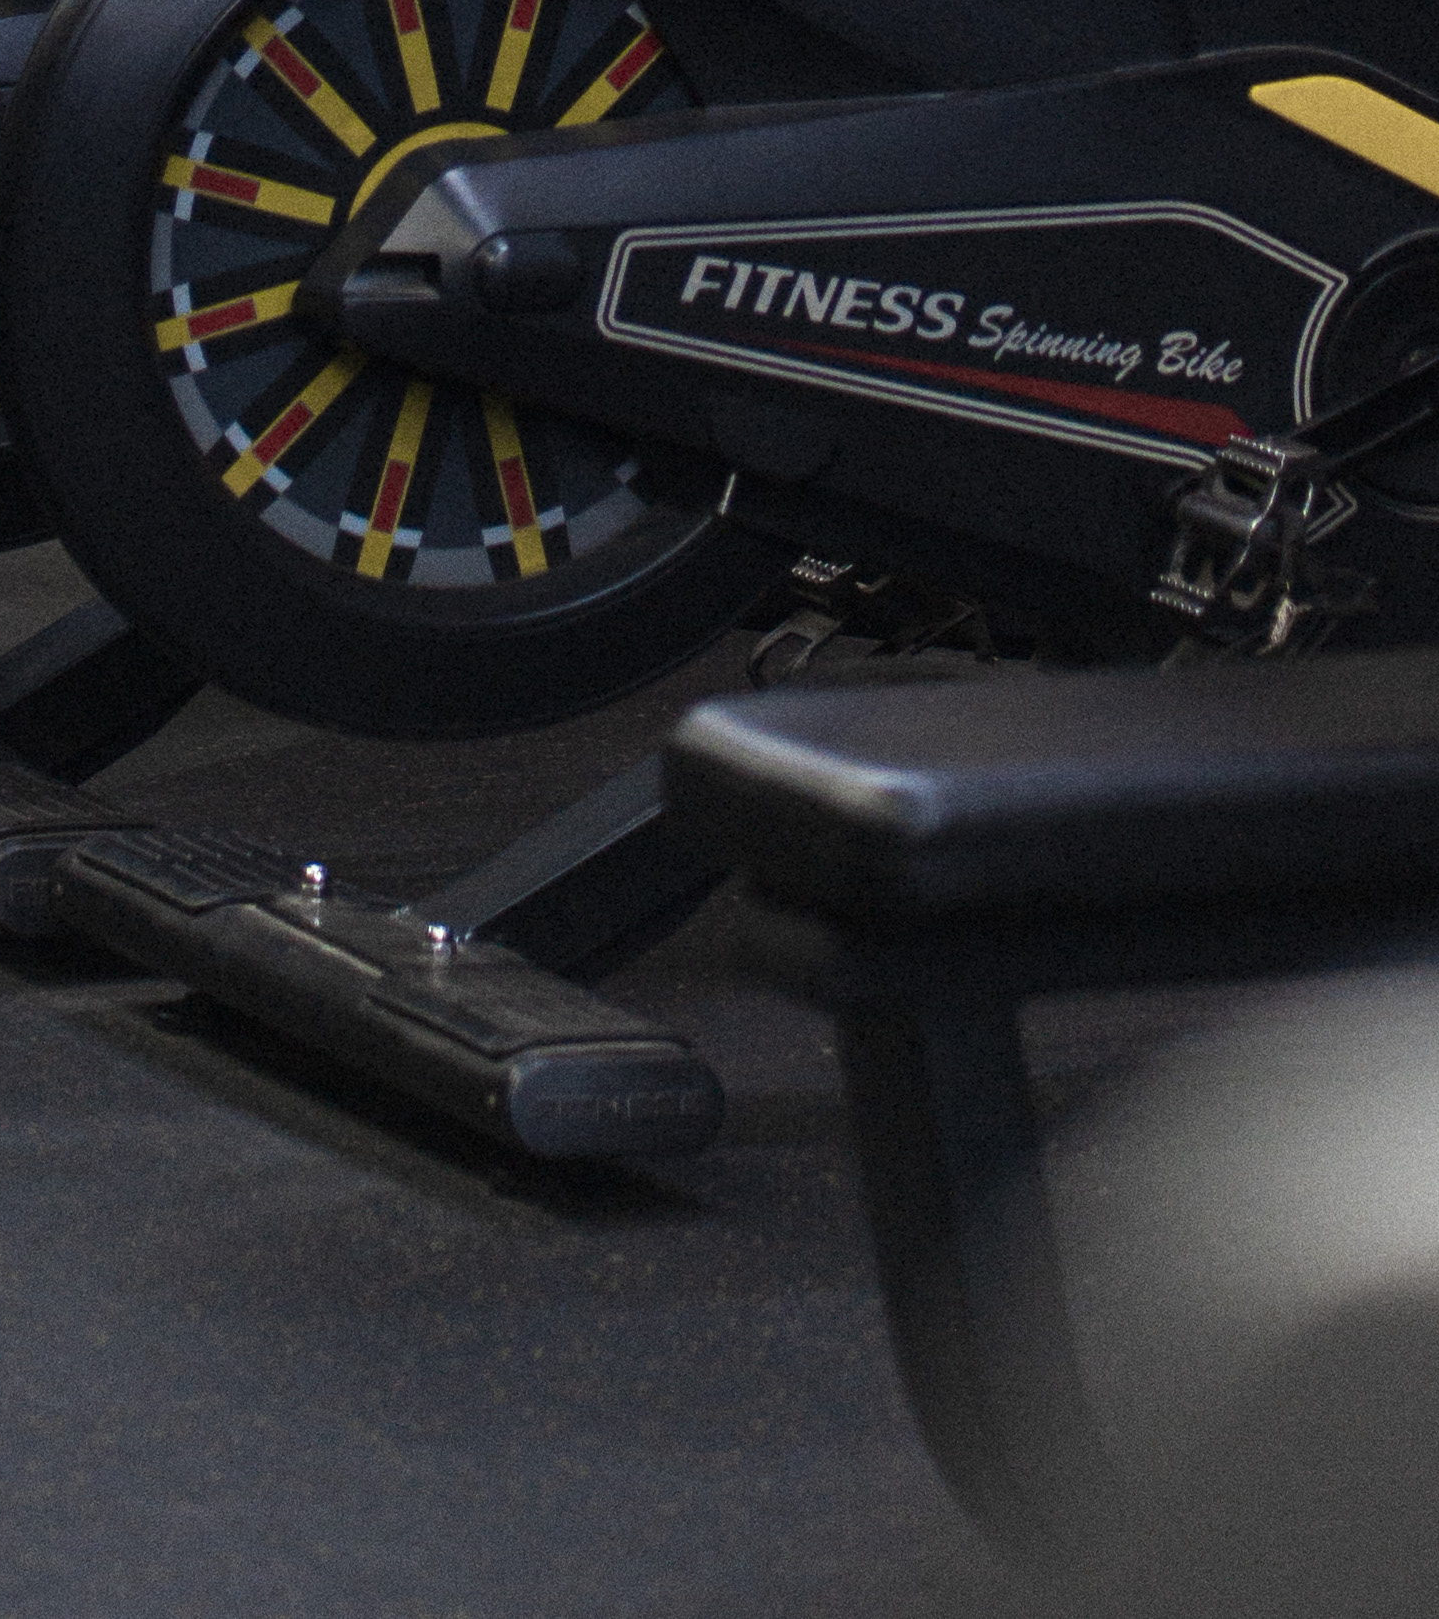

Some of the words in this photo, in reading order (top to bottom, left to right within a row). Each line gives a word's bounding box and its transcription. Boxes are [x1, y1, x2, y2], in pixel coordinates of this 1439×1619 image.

[680, 255, 966, 339] FITNESS
[968, 304, 1146, 383] Spinning
[1155, 330, 1245, 384] Bike
